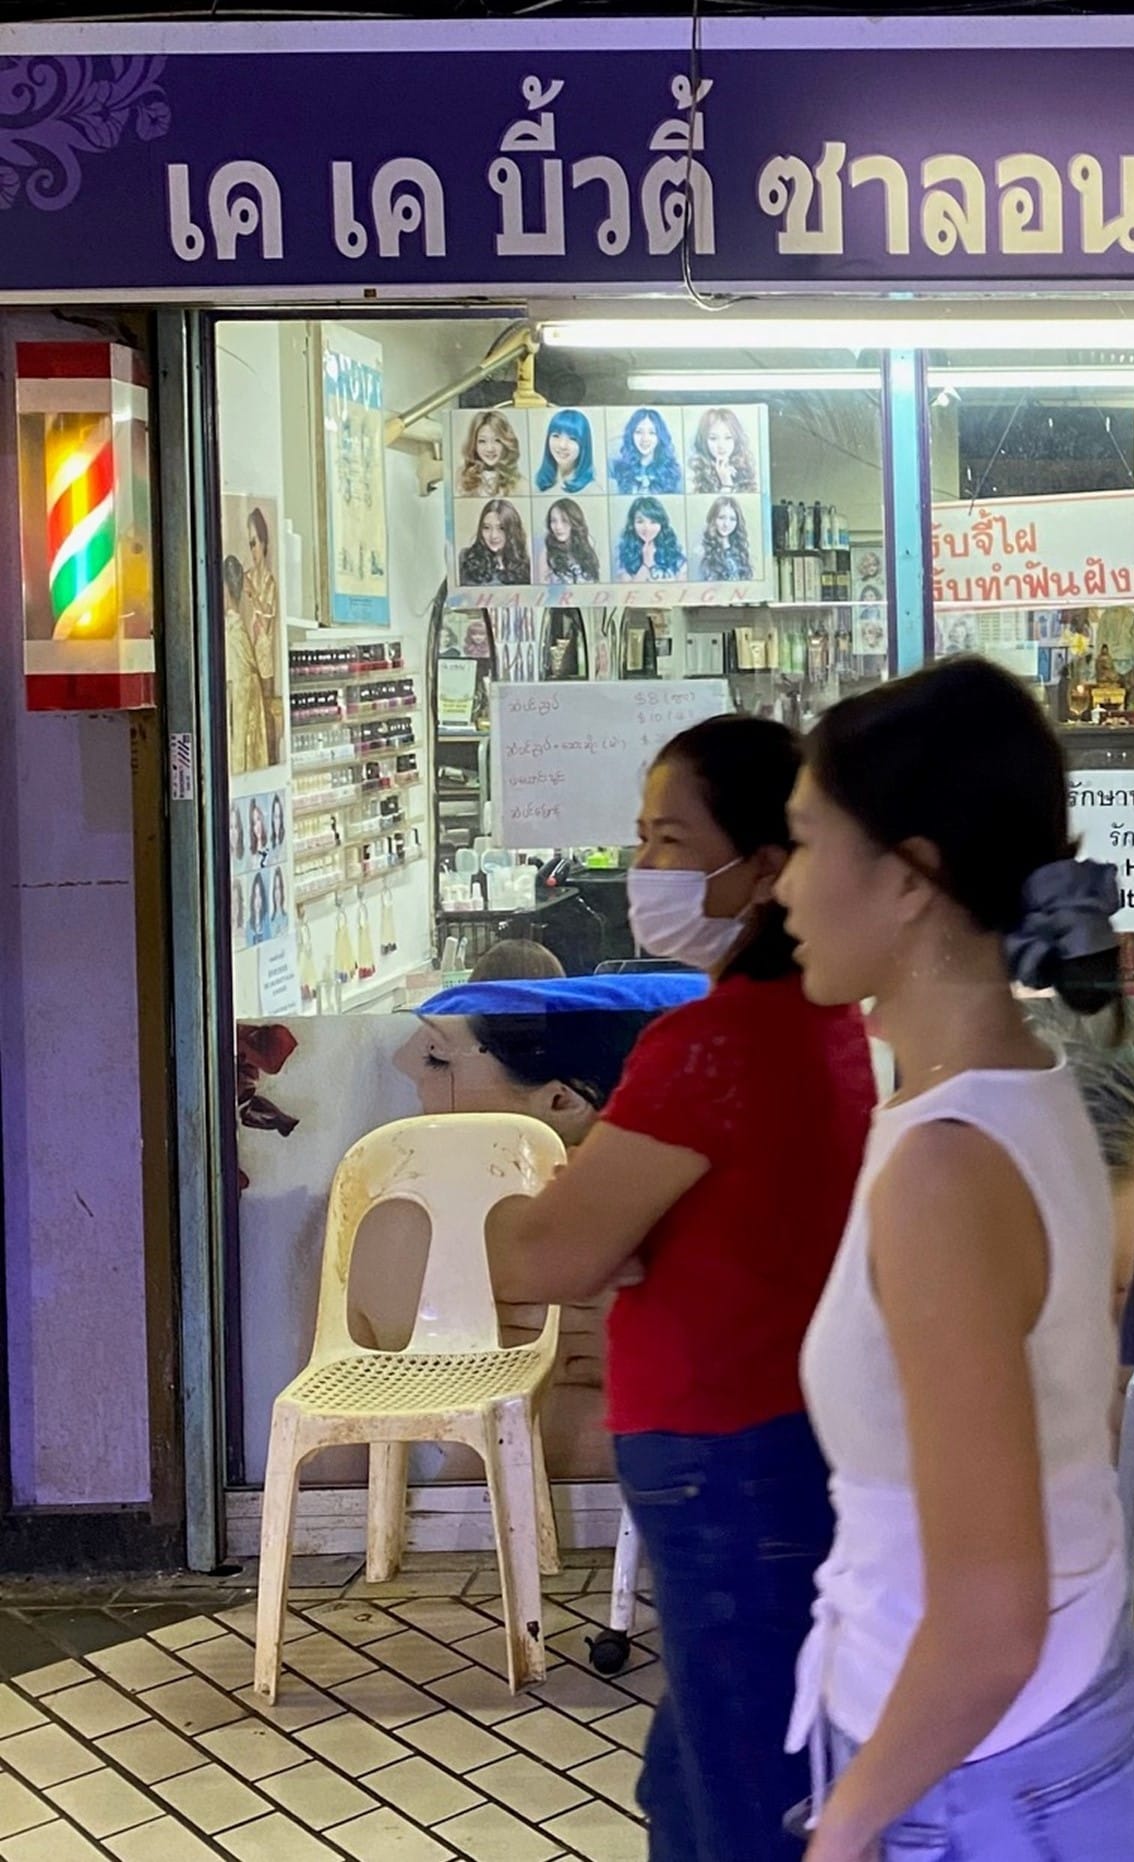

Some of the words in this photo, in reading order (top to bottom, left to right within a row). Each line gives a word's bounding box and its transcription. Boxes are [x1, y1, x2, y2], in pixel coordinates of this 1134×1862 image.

[167, 160, 284, 261] เค
[330, 157, 446, 259] เค
[475, 590, 571, 606] HAIR
[593, 587, 749, 606] DESIGN
